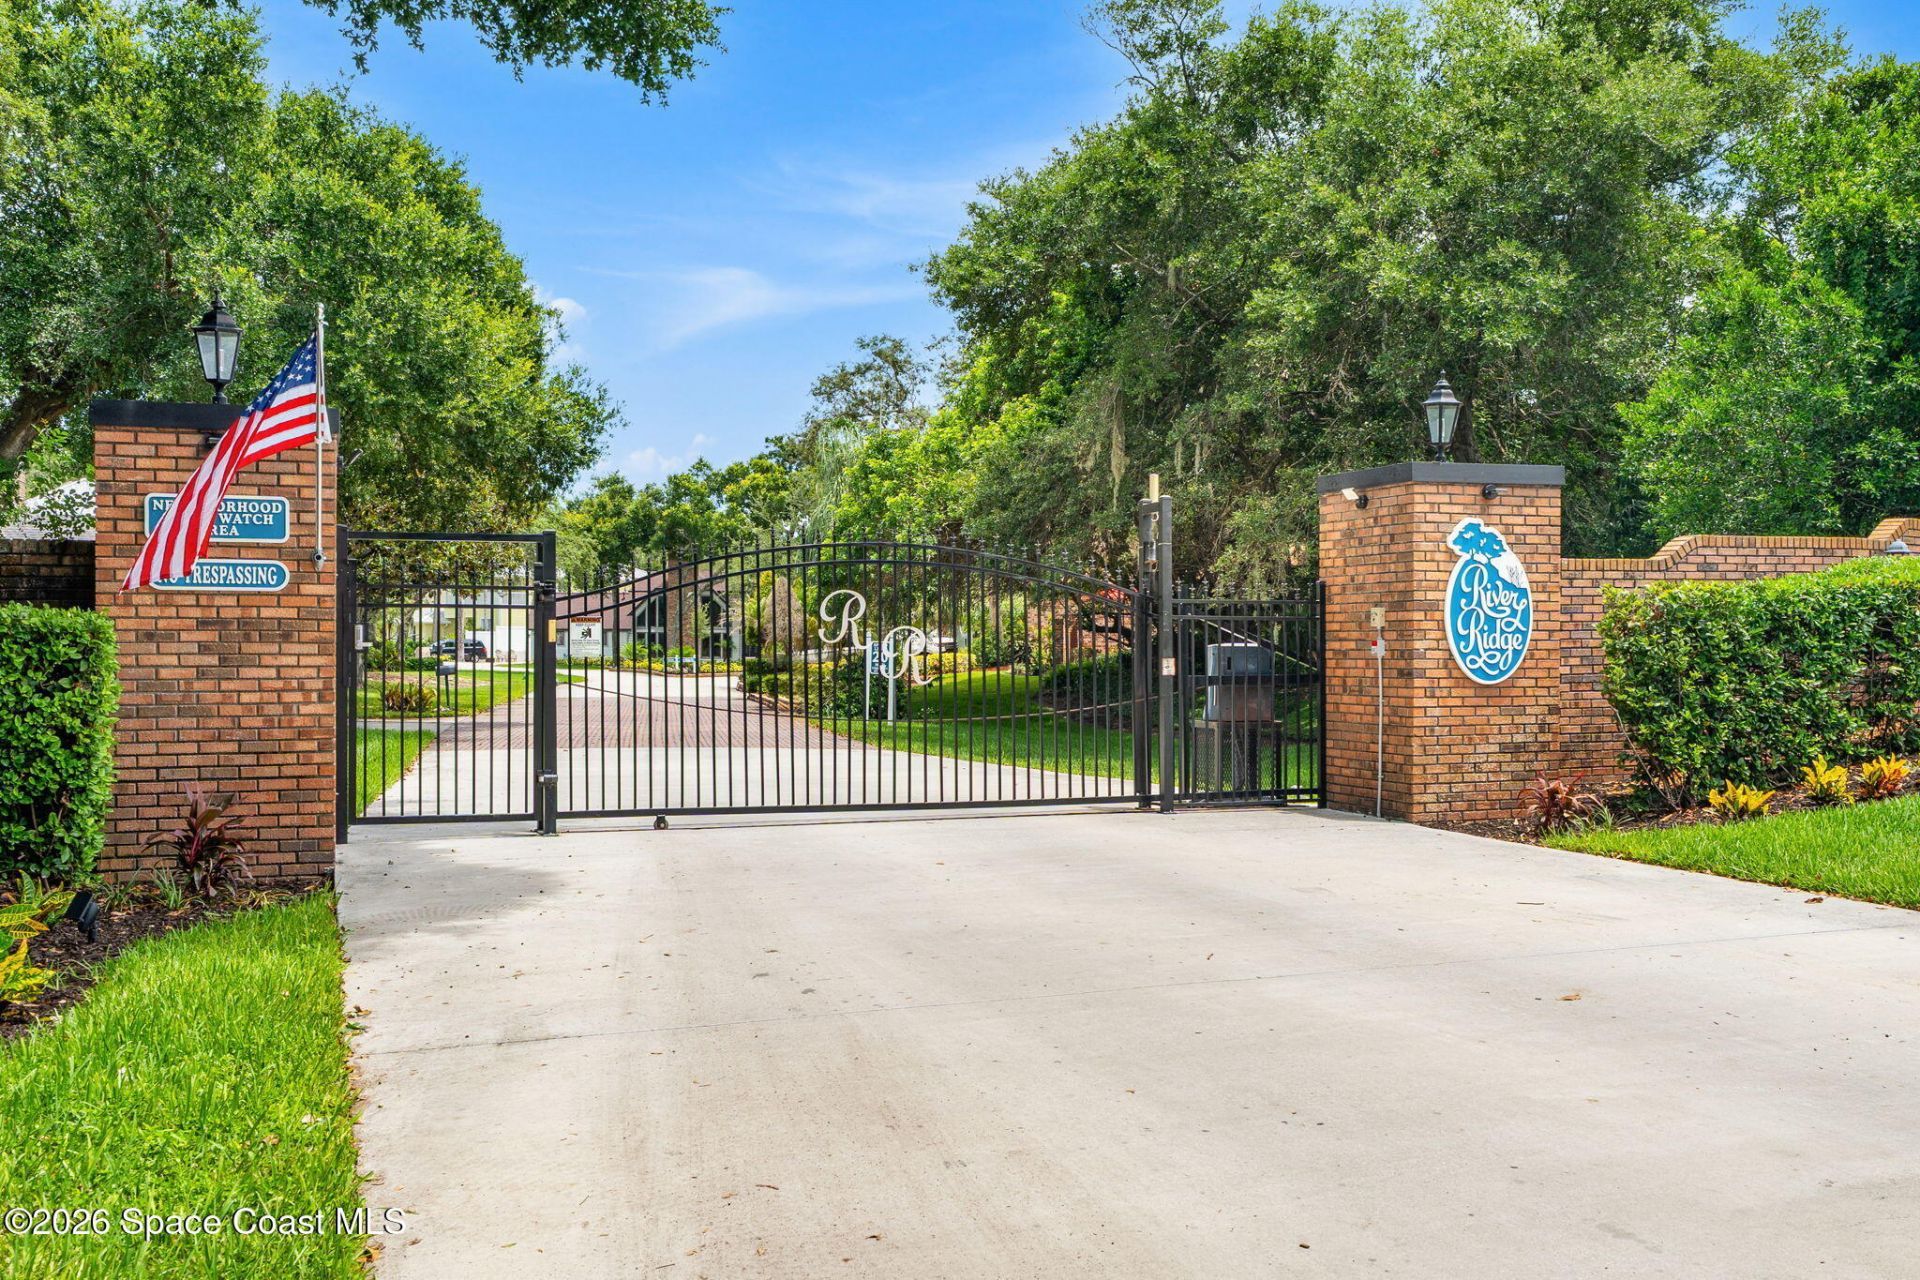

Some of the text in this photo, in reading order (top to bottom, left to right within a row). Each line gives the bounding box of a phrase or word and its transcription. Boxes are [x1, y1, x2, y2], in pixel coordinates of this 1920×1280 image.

[153, 499, 282, 513] NEORHOOD
[219, 514, 274, 525] WATCH
[210, 525, 240, 536] REA
[185, 565, 277, 585] RESPASSING
[1460, 563, 1528, 632] River
[1456, 607, 1523, 676] Ridge
